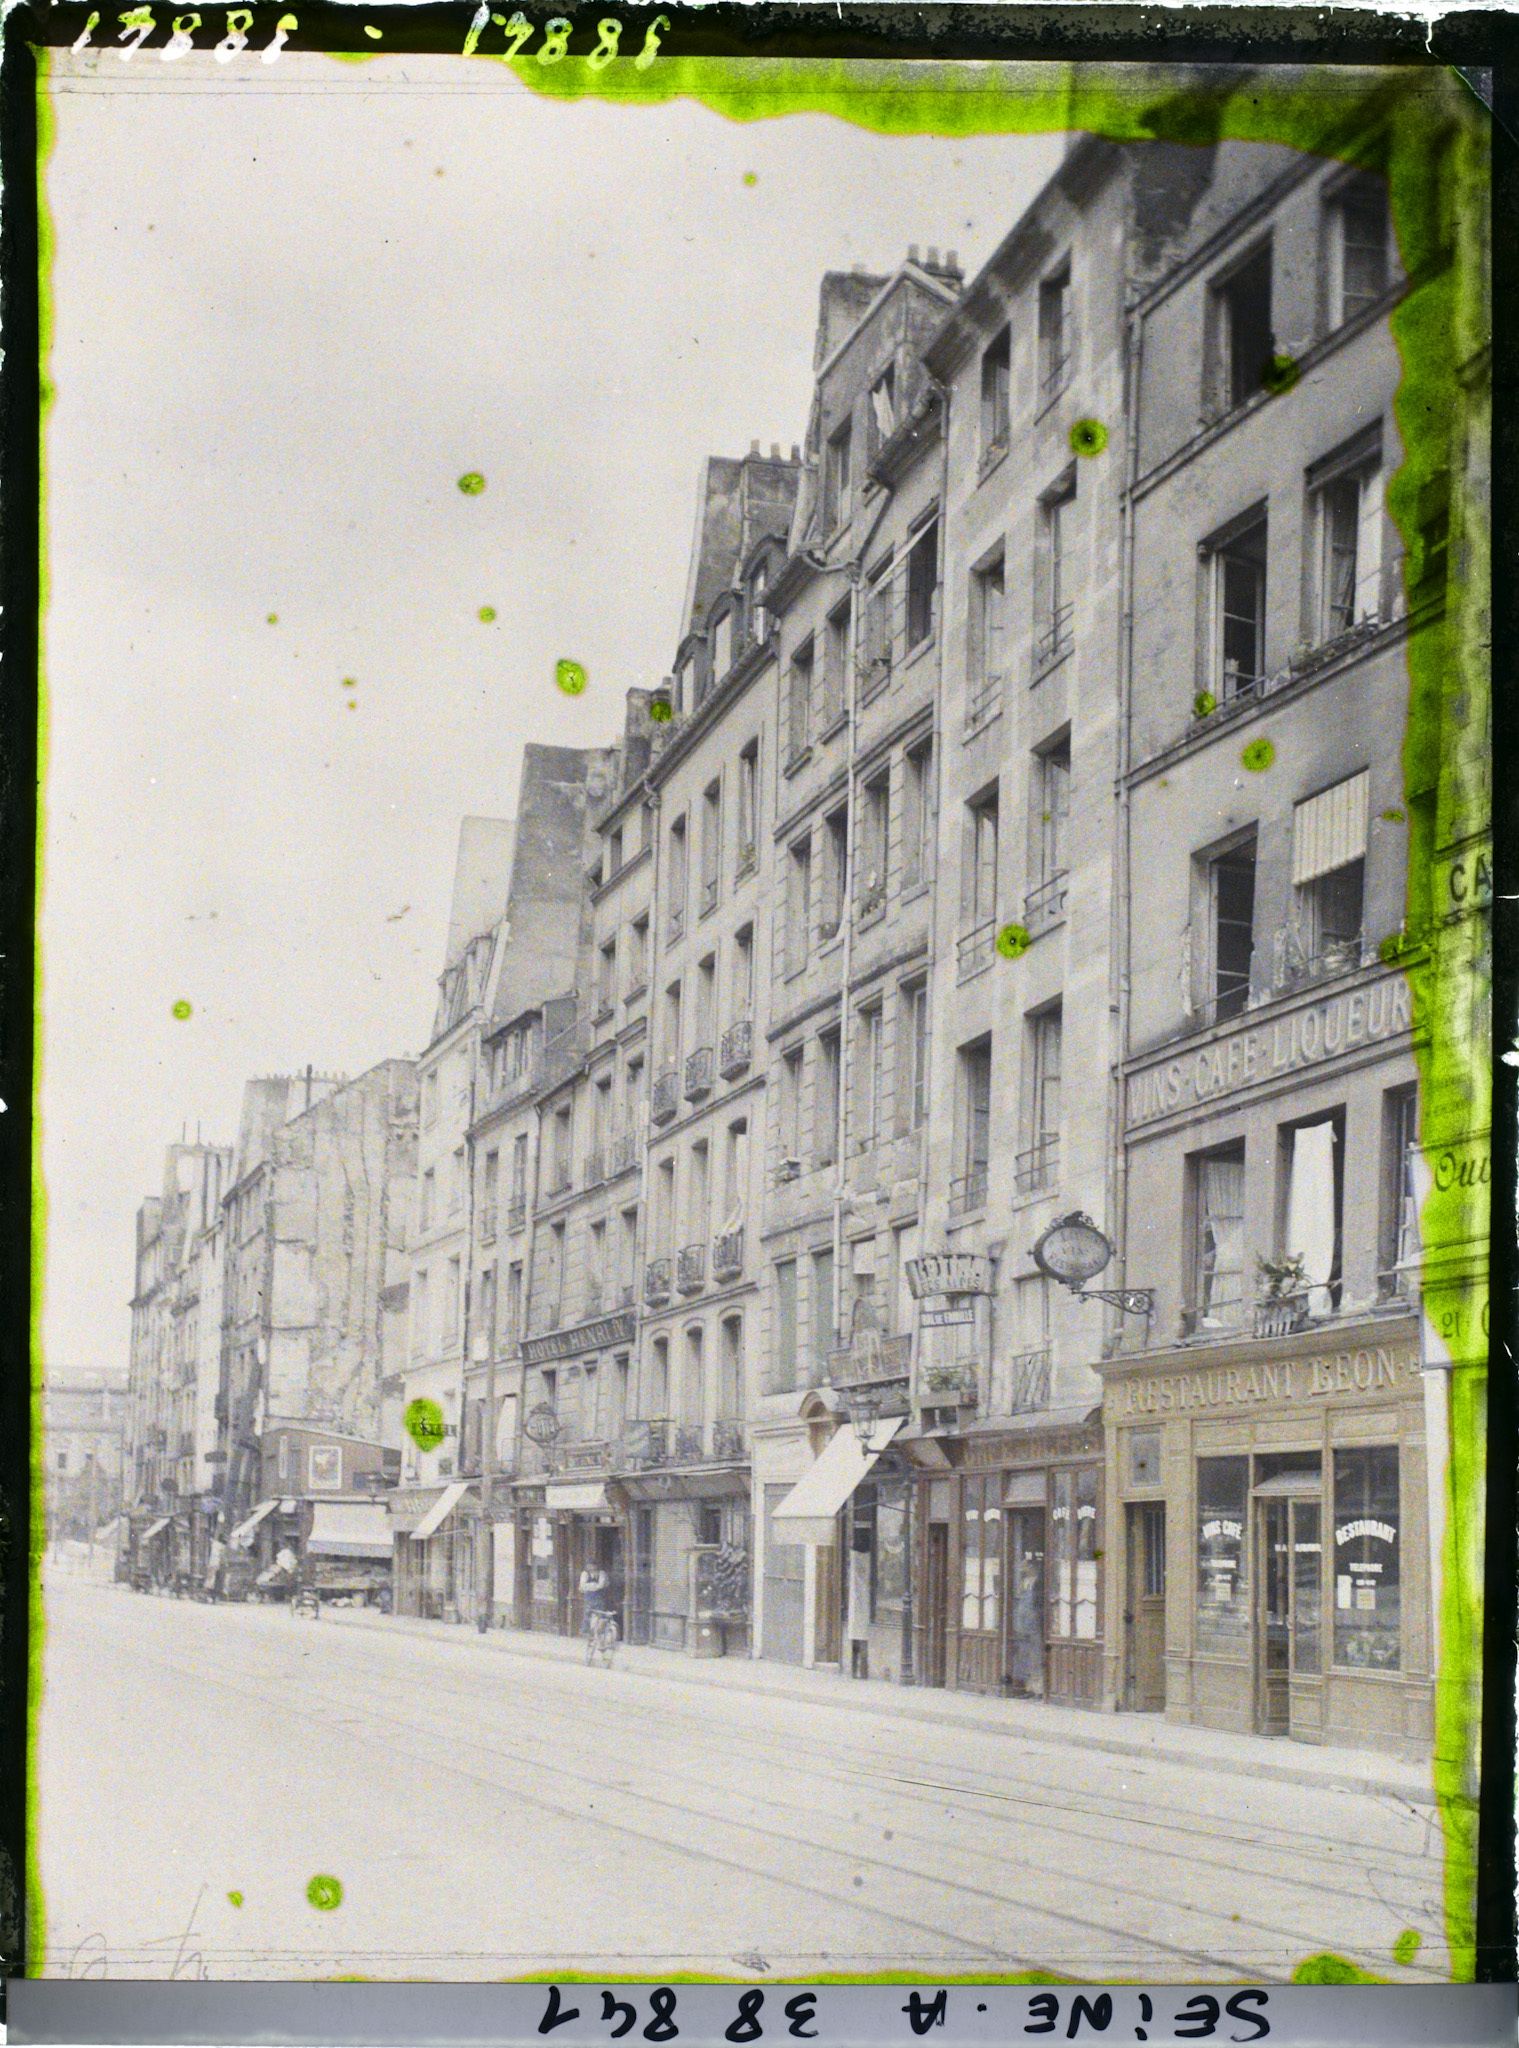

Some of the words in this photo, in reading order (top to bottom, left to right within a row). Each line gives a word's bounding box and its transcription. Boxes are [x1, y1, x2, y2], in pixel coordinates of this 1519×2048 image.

[1123, 1360, 1298, 1416] RESTAURANT
[1335, 1519, 1397, 1546] RESTAURANT
[725, 1989, 819, 2043] 38
